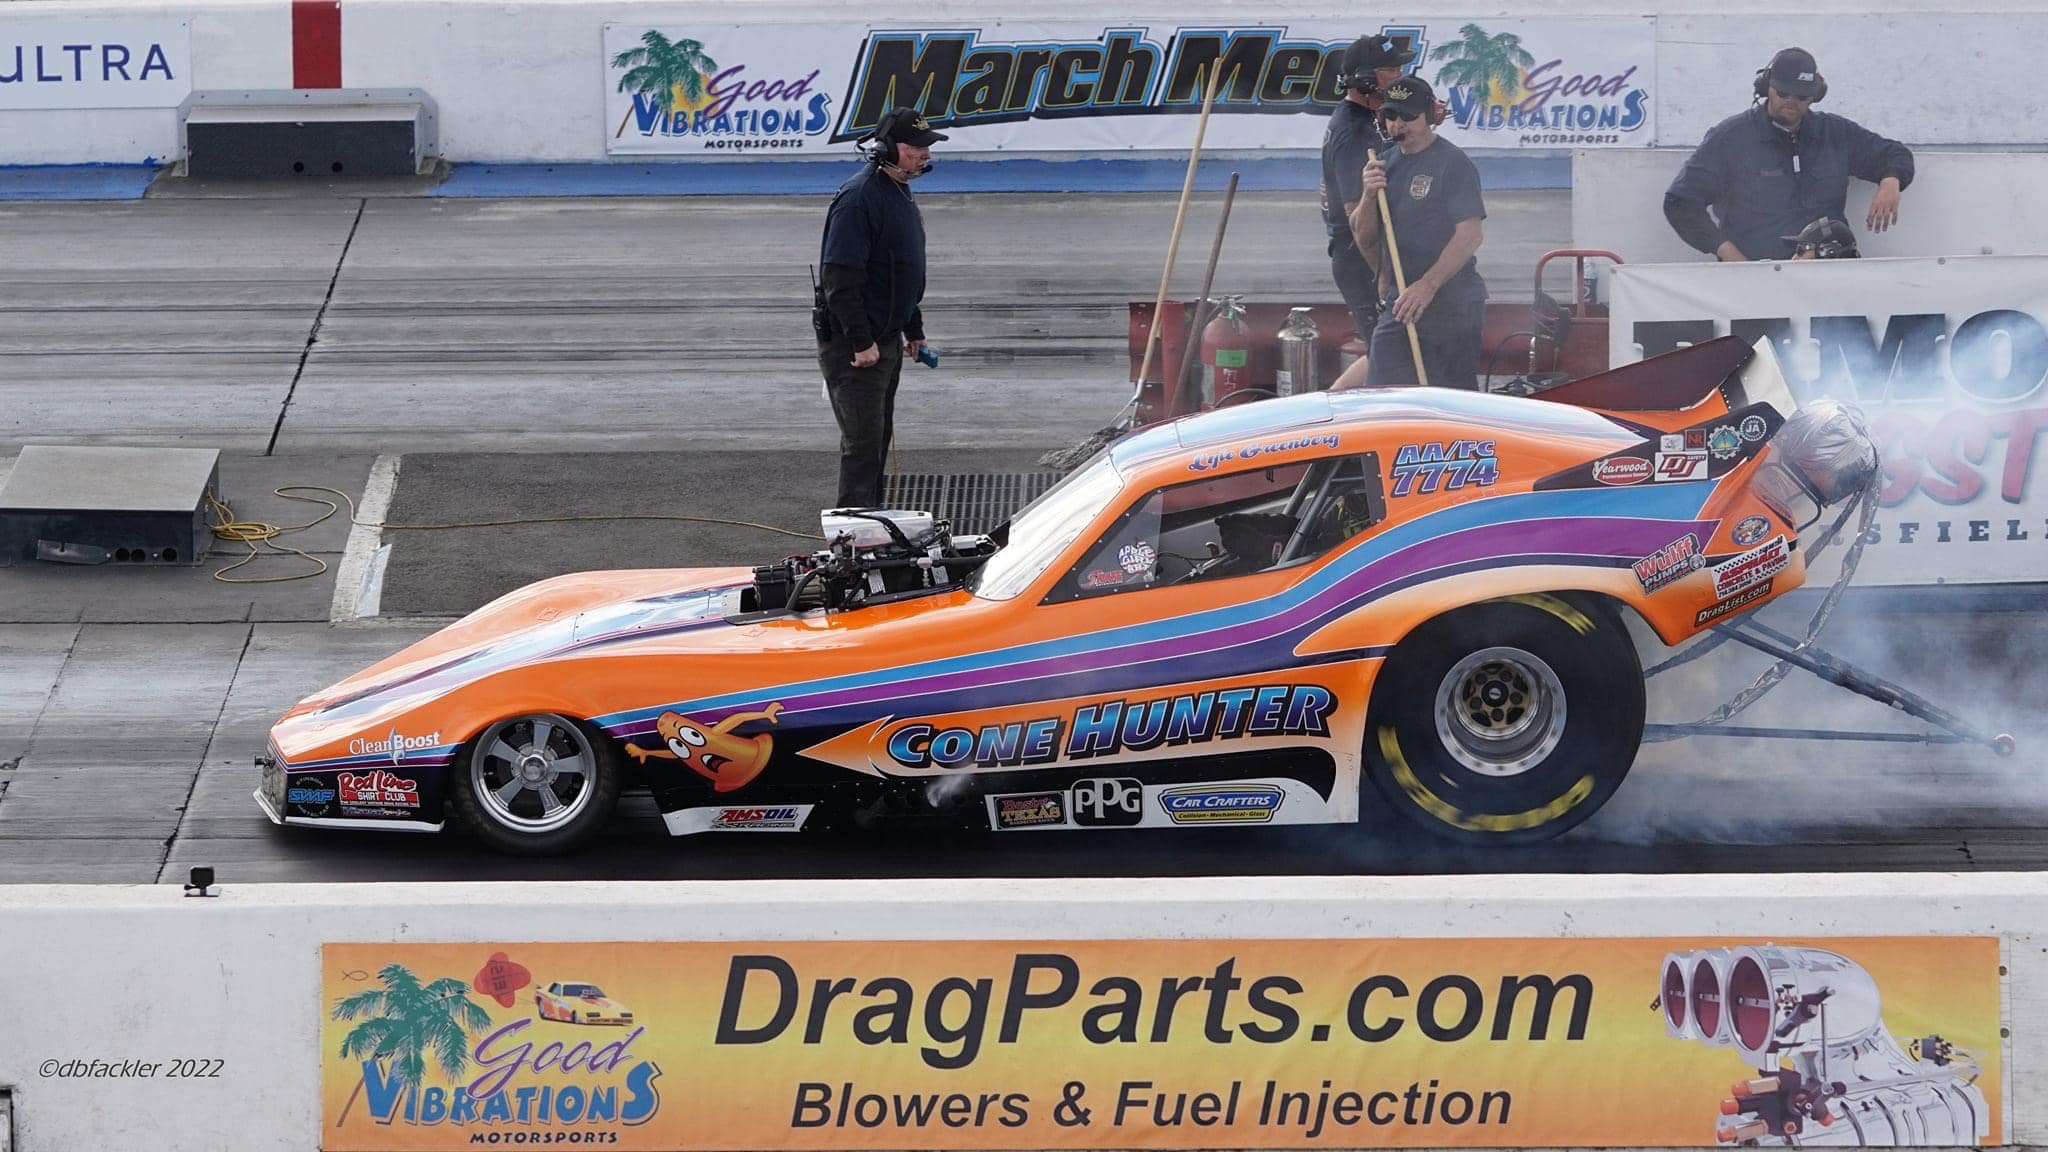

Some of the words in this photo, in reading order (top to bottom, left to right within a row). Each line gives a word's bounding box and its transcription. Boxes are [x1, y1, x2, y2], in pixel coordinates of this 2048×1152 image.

[704, 64, 820, 119] Good
[832, 27, 1164, 140] March
[1519, 59, 1638, 114] Good
[632, 92, 832, 136] VIBRATIONS
[1448, 88, 1649, 132] VIBRATIONS
[704, 139, 803, 149] MOTORSPORTS
[1519, 134, 1619, 144] MOTORSPORTS
[1395, 439, 1496, 466] AA/FC
[1593, 458, 1648, 481] Yearwood
[1391, 457, 1500, 498] 7774
[1634, 536, 1694, 581] Wulff
[1645, 560, 1690, 587] PUMPS
[1698, 582, 1770, 622] DragList.com
[349, 732, 440, 755] CleanBoost
[888, 718, 1060, 767] CONE
[1065, 684, 1335, 757] HUNTER
[338, 771, 378, 796] Red
[376, 770, 418, 792] Line
[357, 791, 380, 801] SHIRT
[384, 791, 407, 802] CLUB
[1075, 778, 1141, 819] PPG
[1172, 796, 1202, 808] CAR
[1204, 795, 1271, 807] CRAFTERS
[718, 808, 797, 823] AMSOIL
[1001, 806, 1061, 823] TEXAS
[714, 952, 1595, 1069] DragParts.com
[465, 1017, 645, 1100] Good
[361, 1060, 664, 1126] VIBRATIONS
[790, 1079, 1029, 1128] Blowers
[1053, 1080, 1093, 1128] &
[1113, 1078, 1244, 1128] Fuel
[1259, 1077, 1512, 1137] Injection
[469, 1130, 618, 1145] MOTORSPORTS
